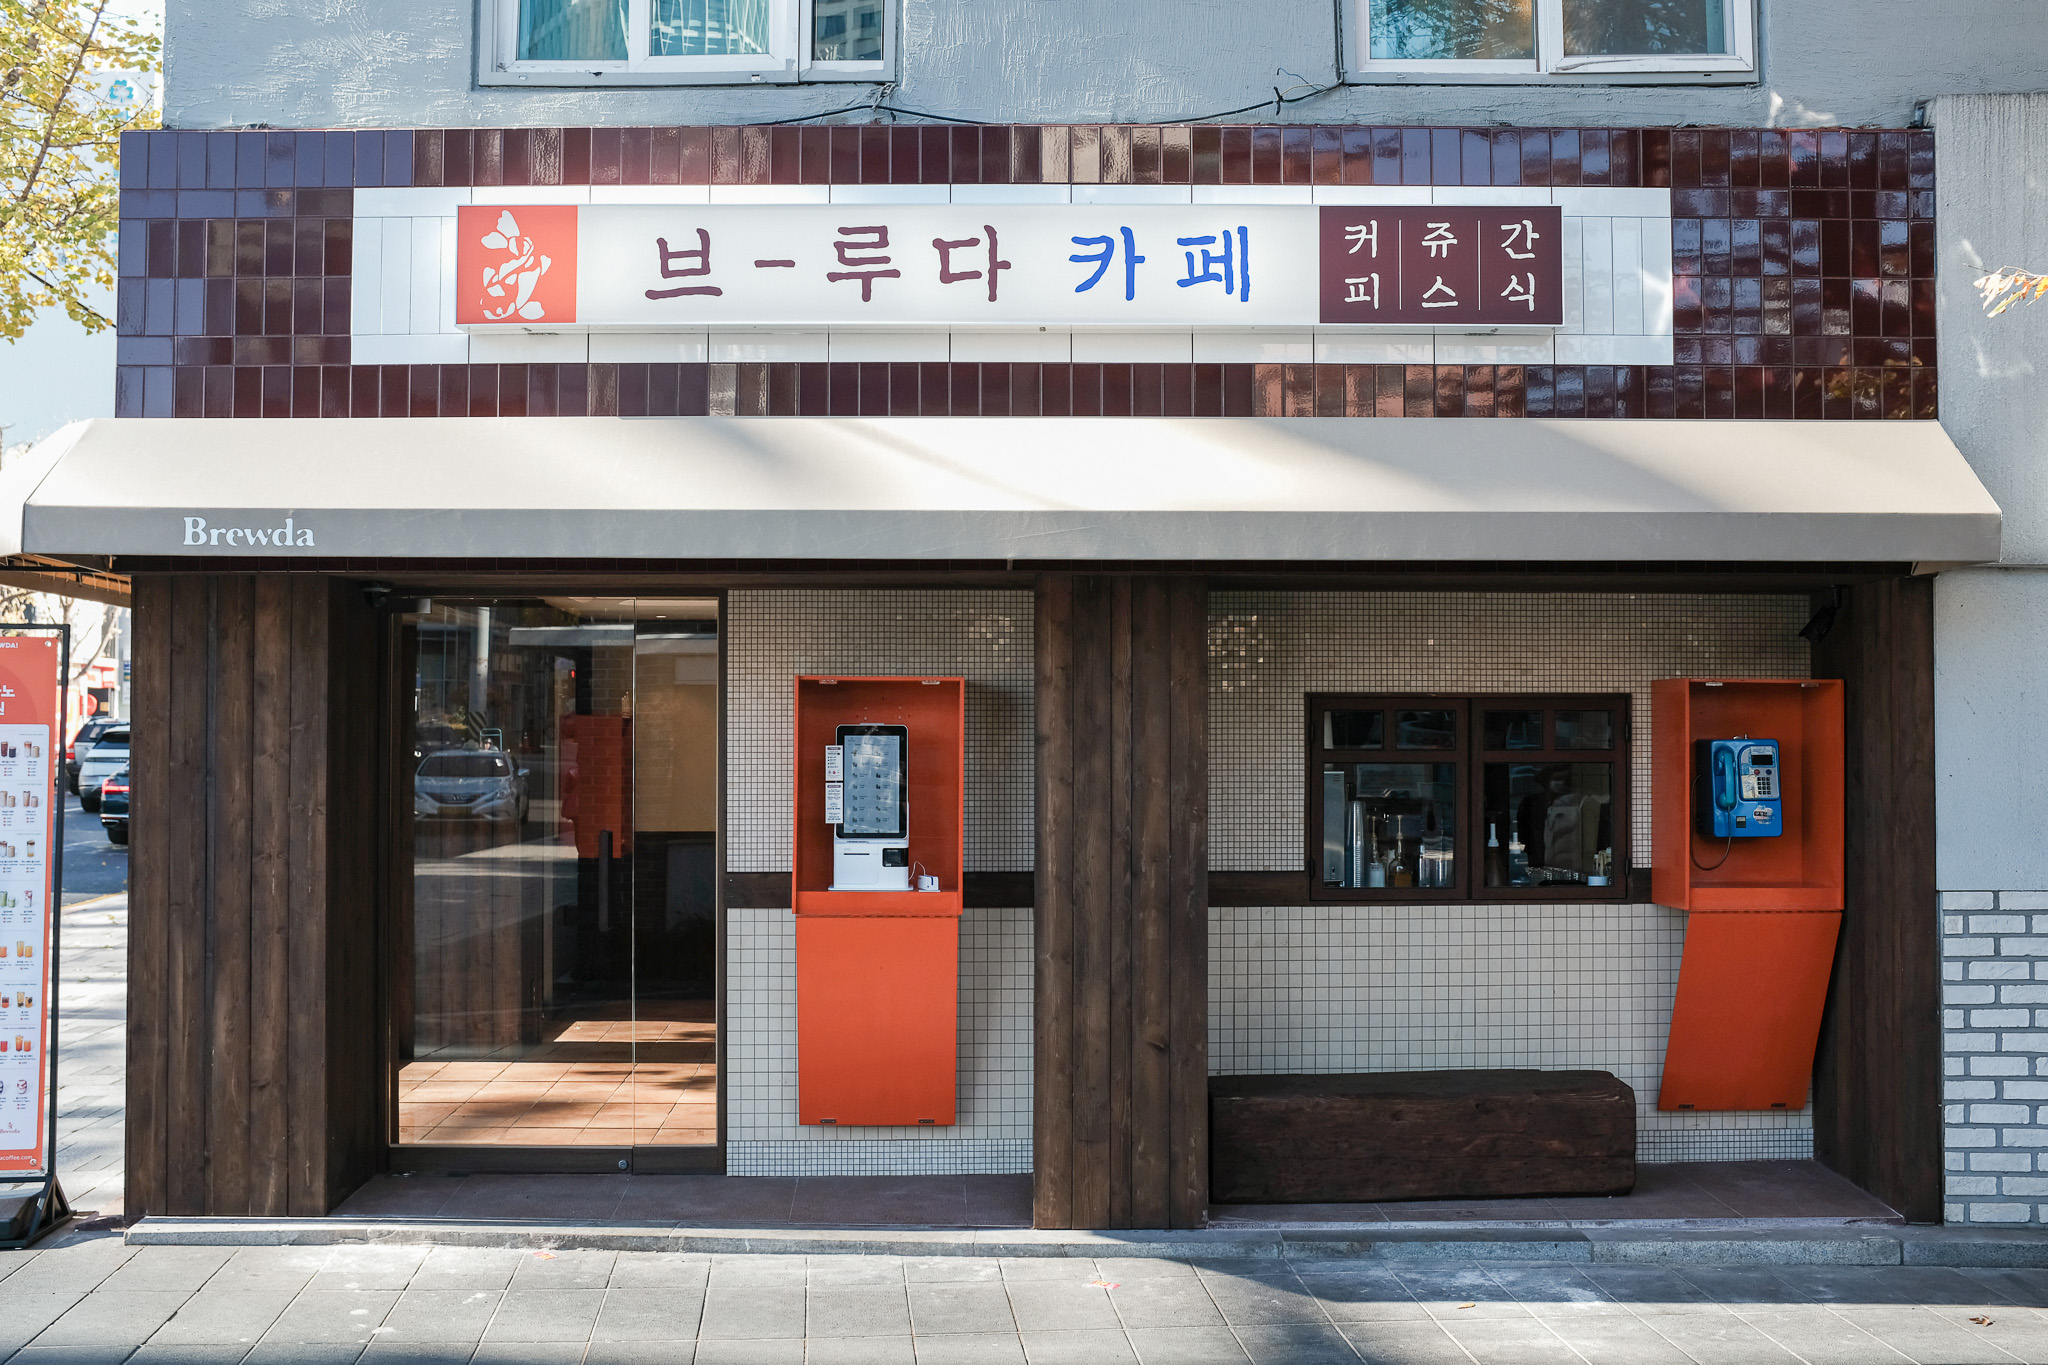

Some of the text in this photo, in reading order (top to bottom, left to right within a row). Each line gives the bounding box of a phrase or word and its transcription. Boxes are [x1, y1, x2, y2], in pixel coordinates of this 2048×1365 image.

[1068, 225, 1251, 303] 카페
[1344, 219, 1380, 310] 커피
[1421, 222, 1459, 308] 쥬스
[1500, 219, 1540, 312] 간식
[183, 516, 315, 547] Brewda
